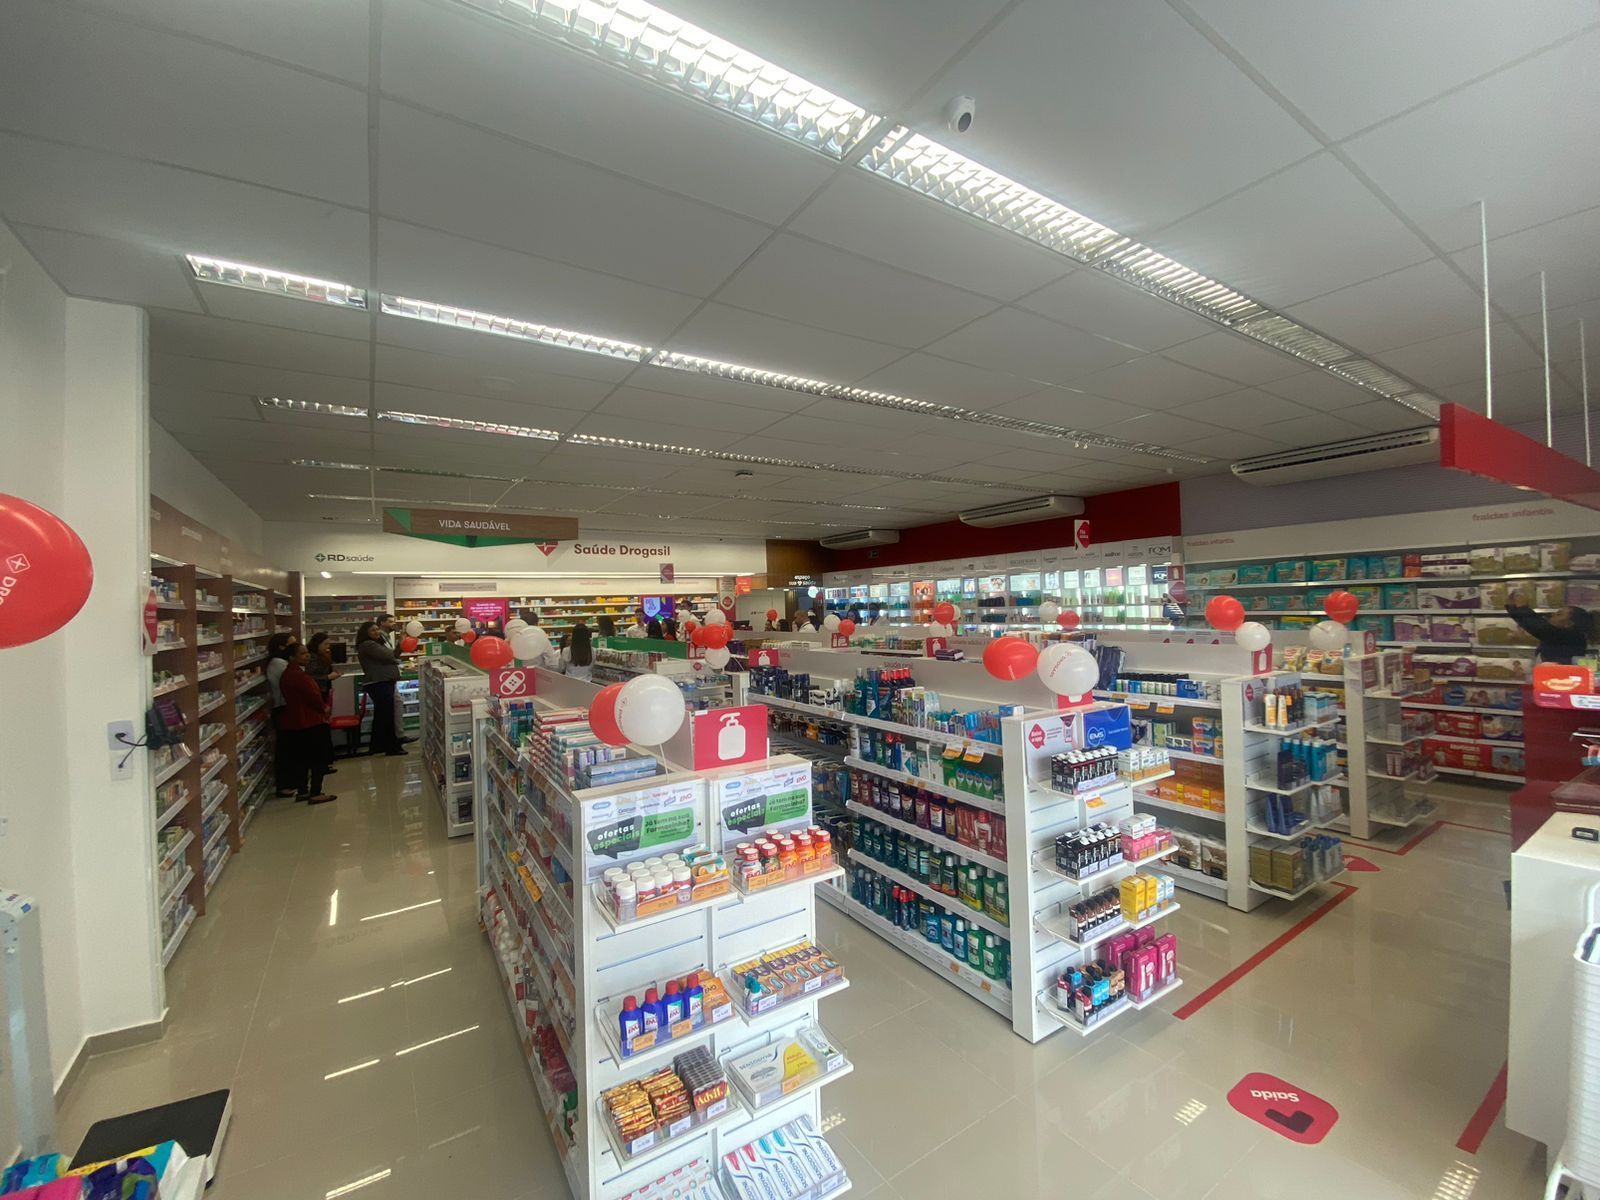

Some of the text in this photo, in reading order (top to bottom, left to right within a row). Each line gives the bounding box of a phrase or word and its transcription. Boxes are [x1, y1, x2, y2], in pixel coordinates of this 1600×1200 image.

[438, 519, 511, 532] VIDA SAUDÁVEL
[574, 542, 671, 559] Saúde Drogasil
[727, 808, 765, 826] especiais
[730, 802, 761, 818] ofertas
[593, 830, 641, 851] especiais
[597, 825, 635, 841] ofertas
[697, 1089, 721, 1106] Advil
